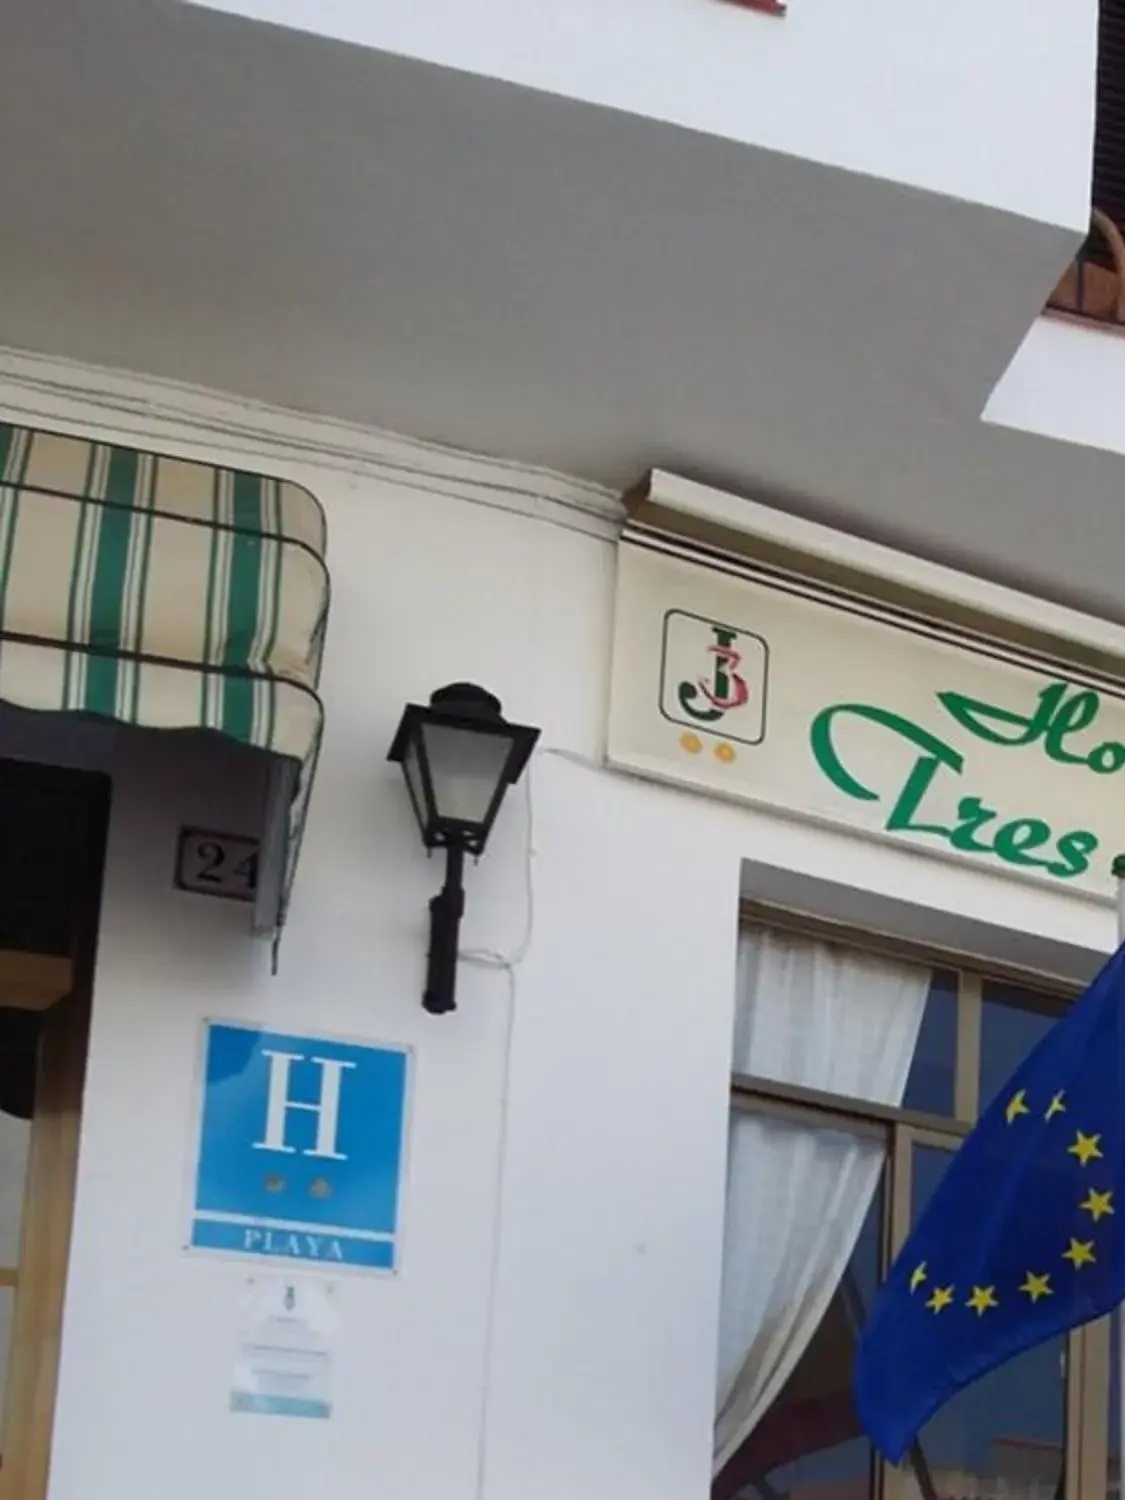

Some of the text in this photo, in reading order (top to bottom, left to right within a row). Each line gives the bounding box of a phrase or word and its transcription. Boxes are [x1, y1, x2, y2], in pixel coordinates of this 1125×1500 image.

[809, 703, 1099, 878] Tres
[252, 1049, 358, 1161] H
[244, 1229, 345, 1262] PLAYA
